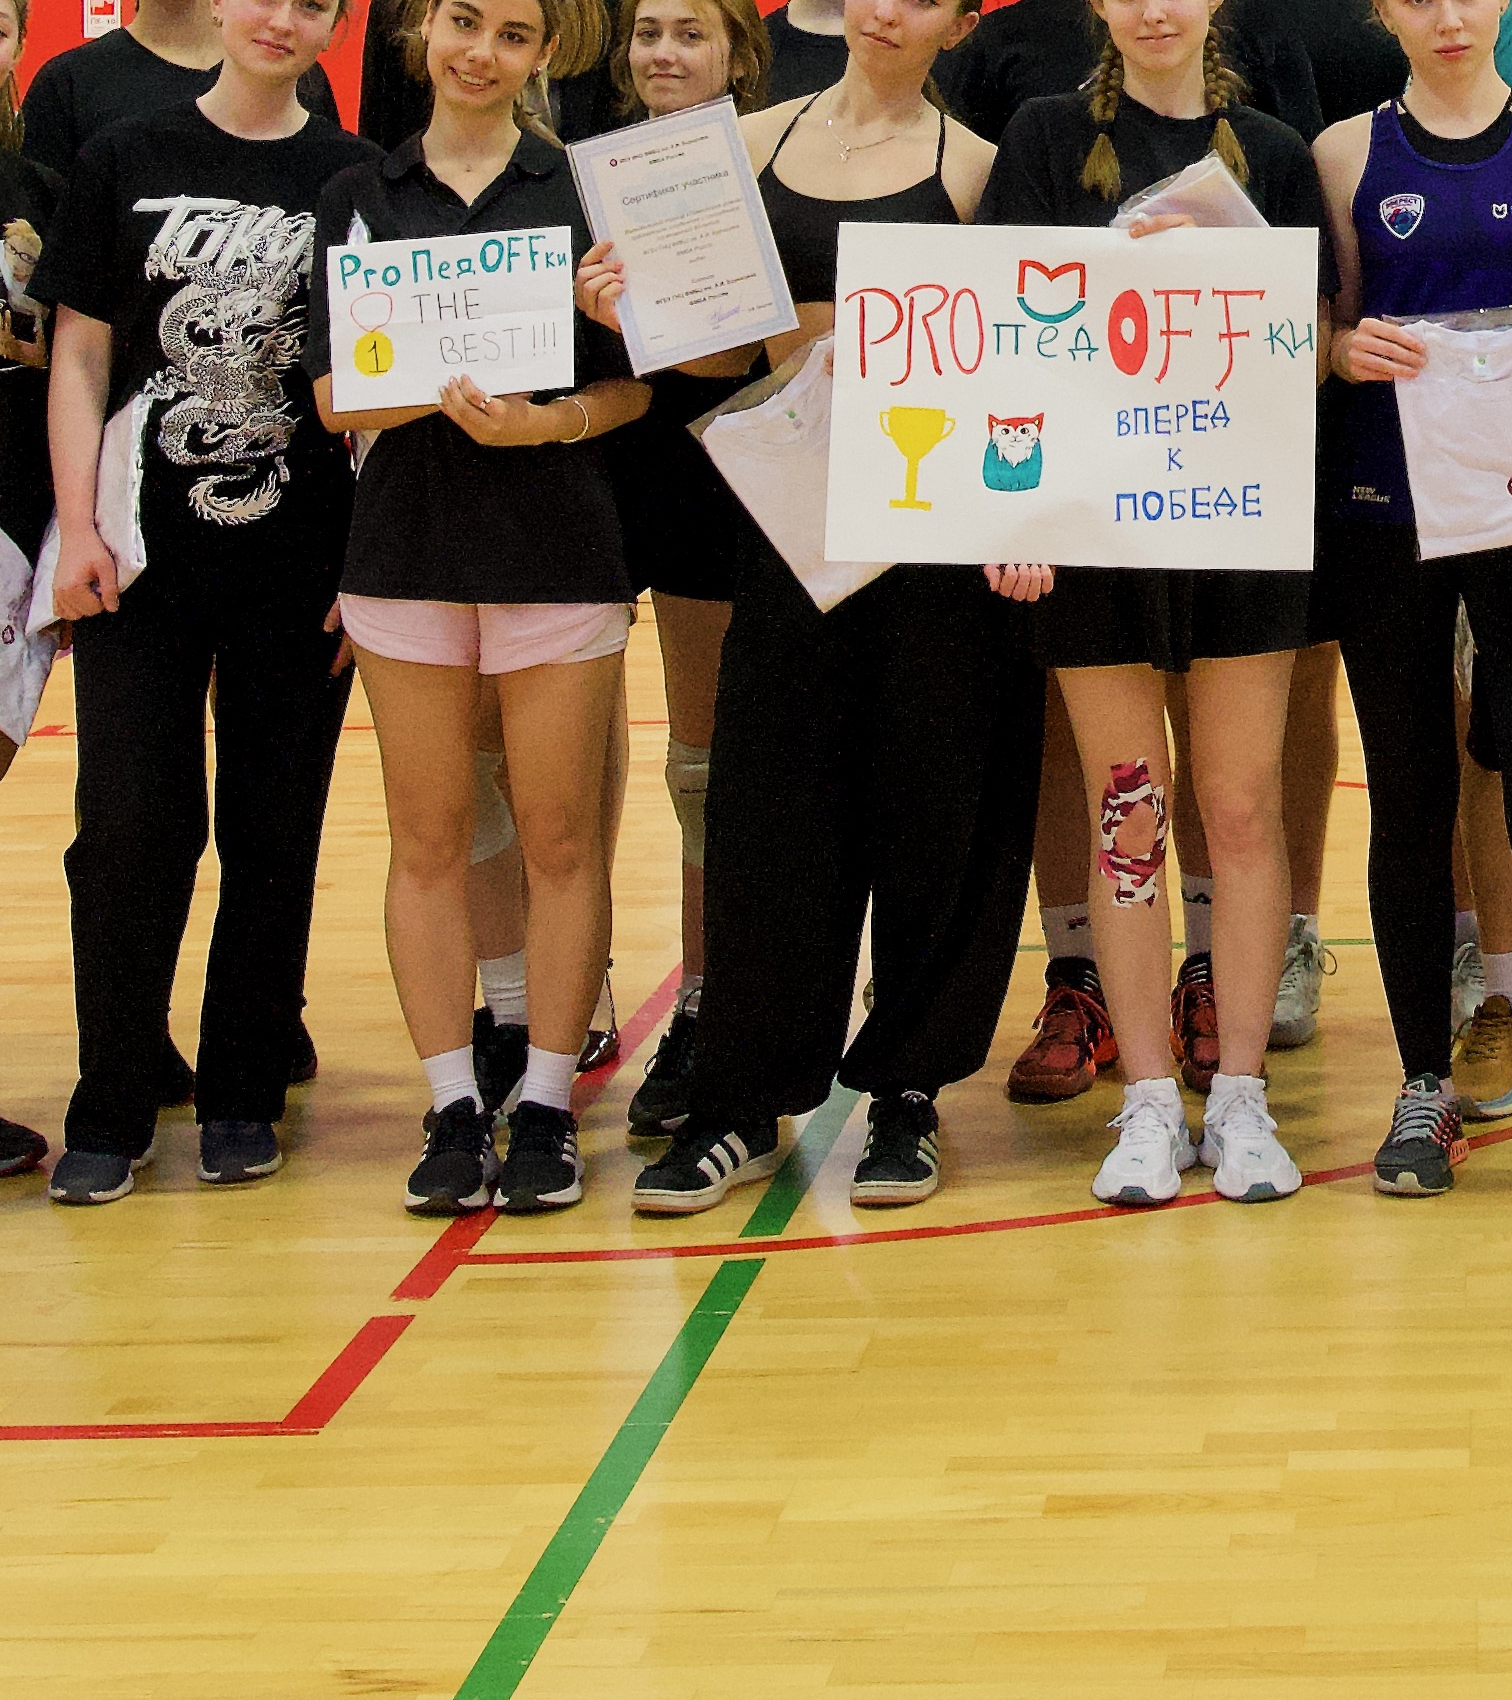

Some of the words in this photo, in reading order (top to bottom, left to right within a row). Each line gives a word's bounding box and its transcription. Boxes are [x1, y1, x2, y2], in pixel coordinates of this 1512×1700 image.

[411, 288, 483, 324] THE
[1116, 400, 1231, 438] ВПЕРЕД
[1165, 447, 1185, 472] К
[1114, 484, 1262, 522] ПОБЕДЕ
